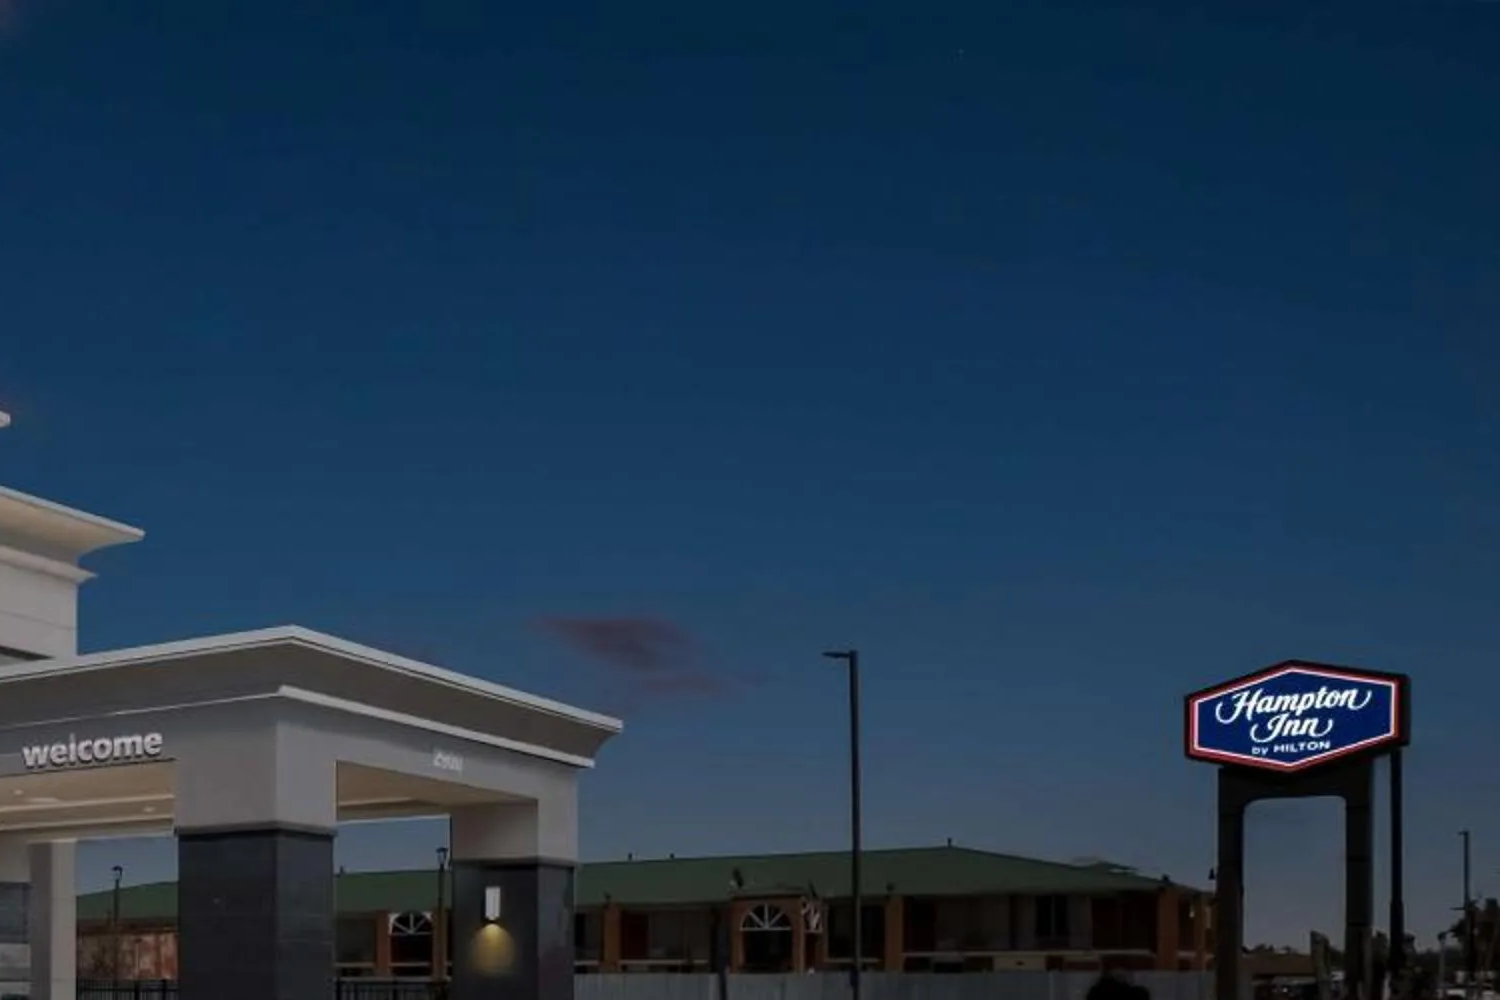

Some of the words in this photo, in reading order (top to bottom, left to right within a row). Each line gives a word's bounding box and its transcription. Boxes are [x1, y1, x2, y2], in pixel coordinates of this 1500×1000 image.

[1215, 685, 1372, 724] Hampton
[1250, 711, 1334, 743] Inn
[21, 731, 163, 768] welcome
[1273, 740, 1331, 753] HILTON
